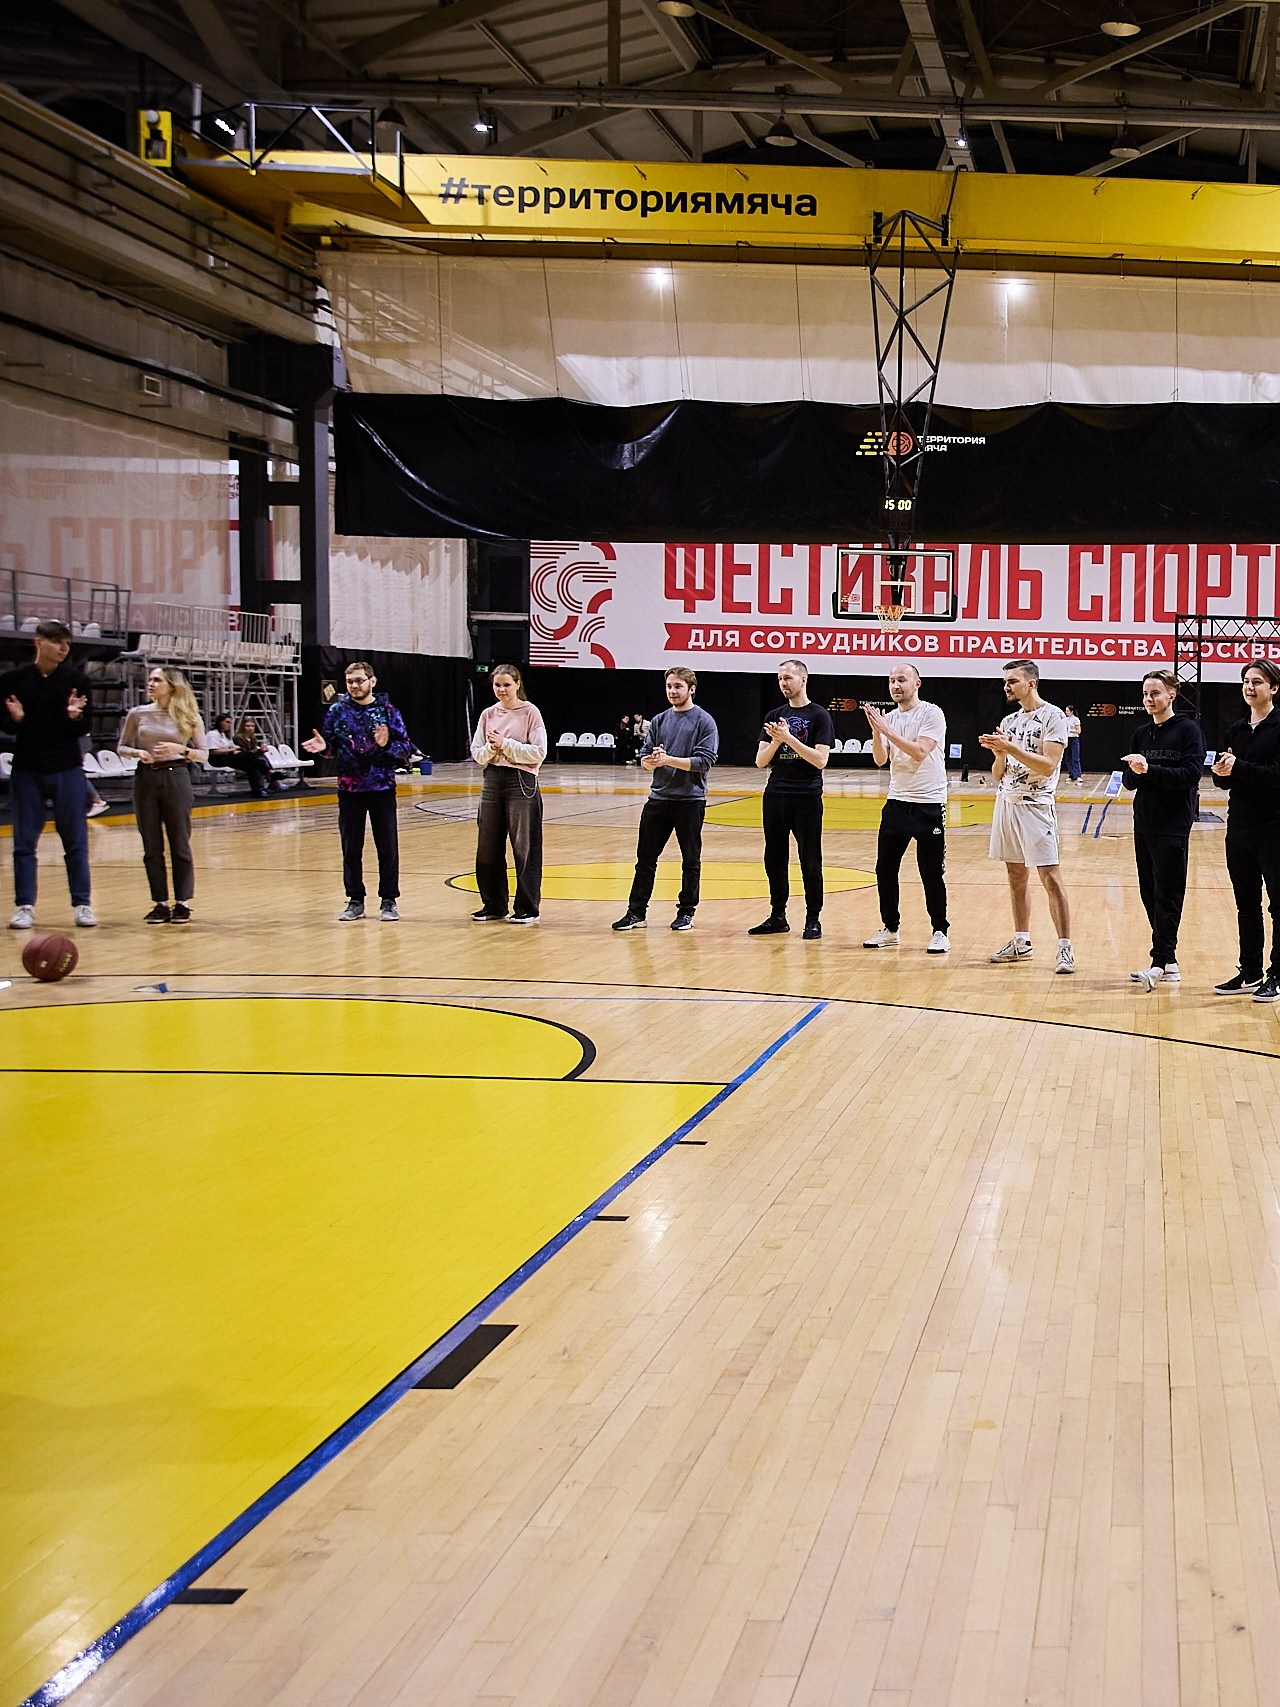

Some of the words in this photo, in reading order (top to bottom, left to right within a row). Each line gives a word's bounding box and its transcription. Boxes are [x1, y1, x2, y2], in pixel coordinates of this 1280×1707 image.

[438, 177, 817, 217] #территориямяча
[50, 516, 240, 595] СПОРТ
[664, 543, 1043, 621] ФЕСТИВАЛЬ
[687, 628, 741, 649] ДЛЯ
[749, 630, 940, 653] СОТРУДНИКОВ
[948, 634, 1168, 657] ПРАВИТЕЛЬСТВА
